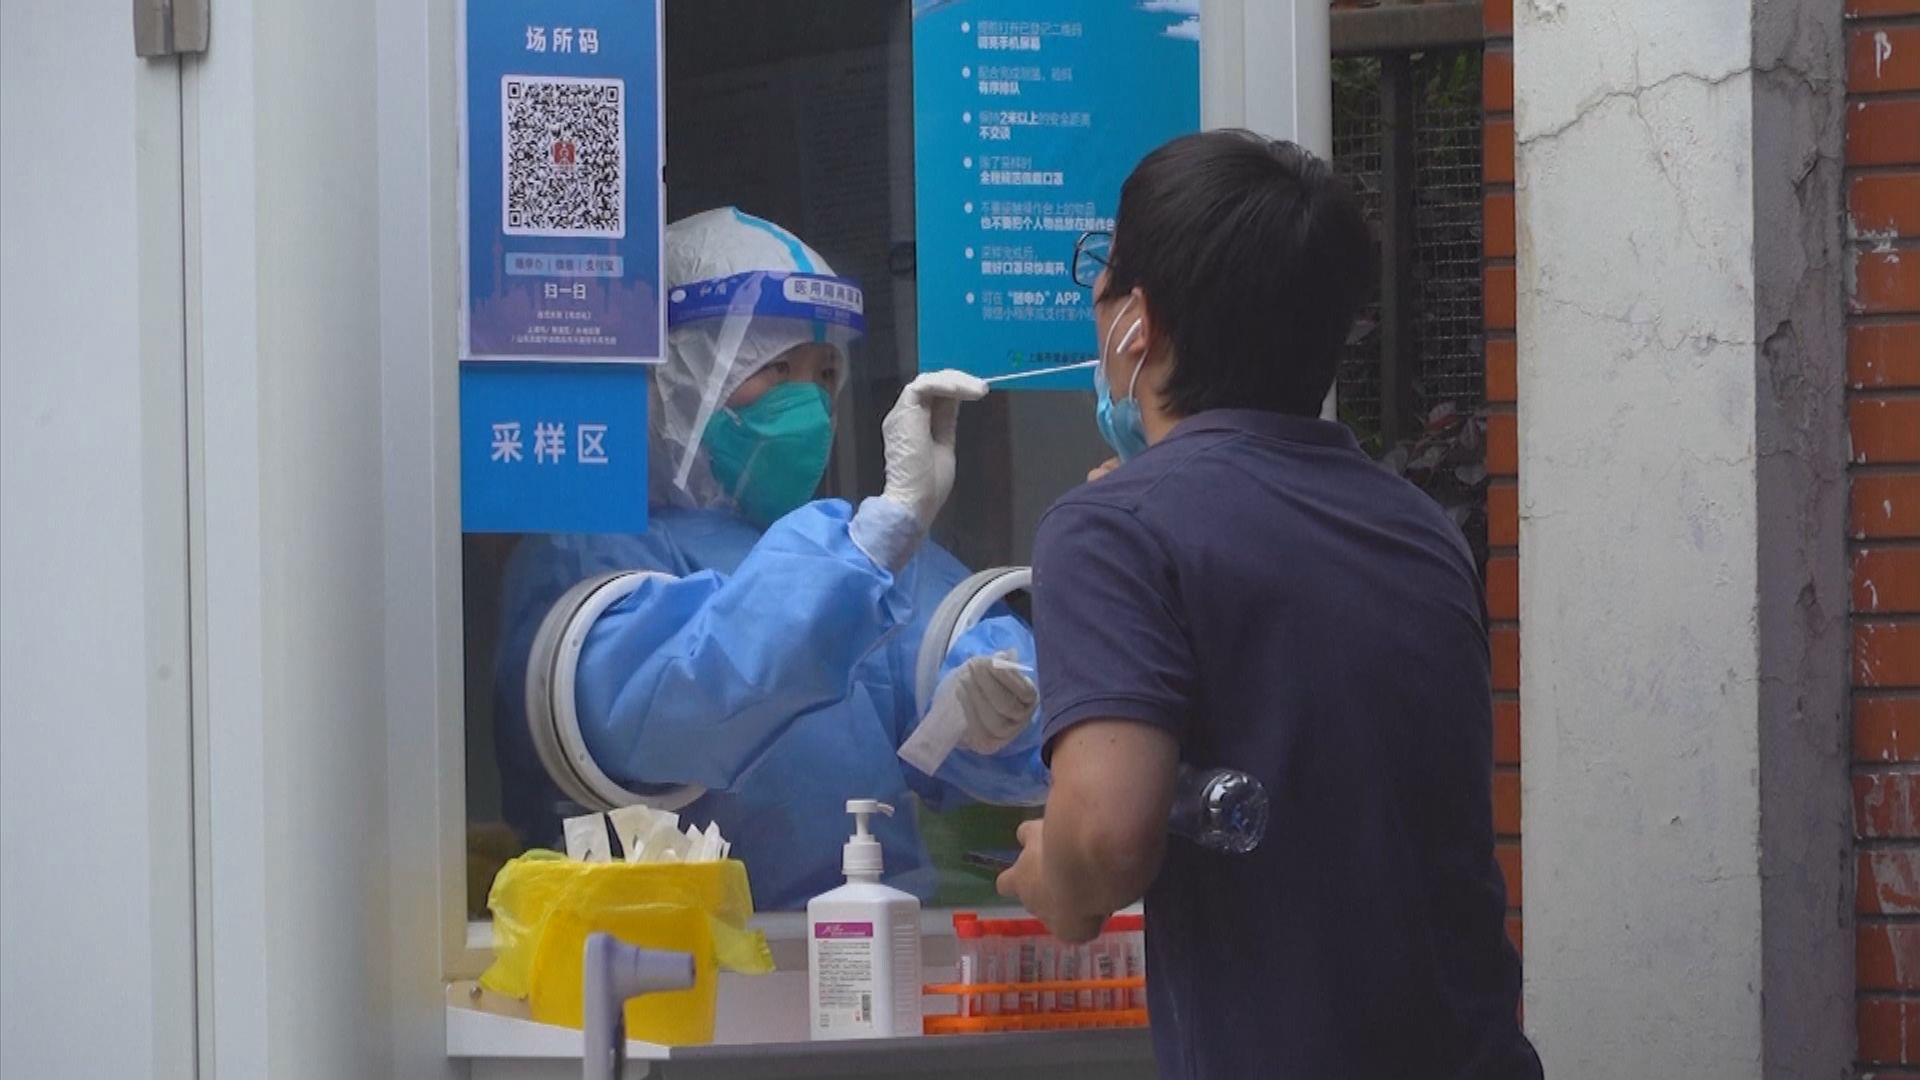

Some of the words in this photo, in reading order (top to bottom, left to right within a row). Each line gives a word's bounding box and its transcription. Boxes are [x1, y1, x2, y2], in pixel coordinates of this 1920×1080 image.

[525, 26, 600, 54] 场所码
[978, 81, 1021, 96] 有序排队
[979, 125, 1011, 141] 不交谈
[585, 259, 616, 273] 支付宝
[543, 282, 587, 300] 扫一扫
[490, 421, 609, 466] 采样区
